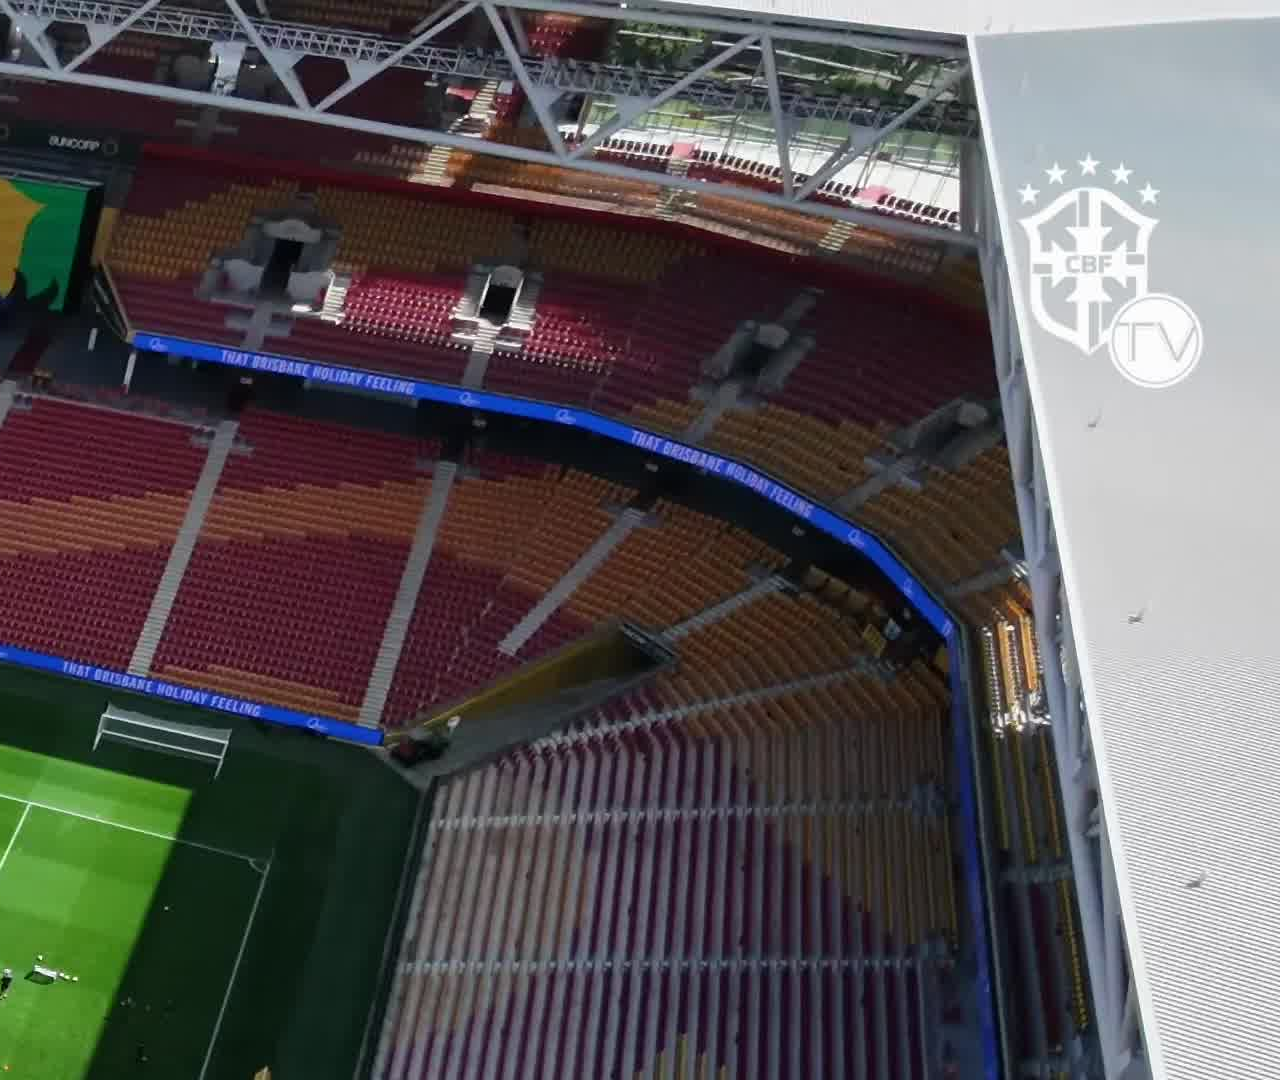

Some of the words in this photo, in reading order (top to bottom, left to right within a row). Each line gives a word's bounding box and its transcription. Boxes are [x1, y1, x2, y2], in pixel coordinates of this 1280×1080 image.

[48, 135, 100, 151] SUNCORP
[220, 350, 249, 368] THAT
[252, 355, 309, 378] BRISBANE
[312, 366, 362, 387] HOLIDAY
[365, 375, 415, 396] FEELING
[630, 430, 661, 452] THAT
[663, 440, 724, 473] BRISBANE
[725, 461, 771, 496] HOLIDAY
[769, 485, 815, 519] FEELING
[63, 661, 92, 679] THAT
[94, 668, 154, 693] BRISBANE
[156, 681, 209, 704] HOLIDAY
[211, 694, 262, 717] FEELING
